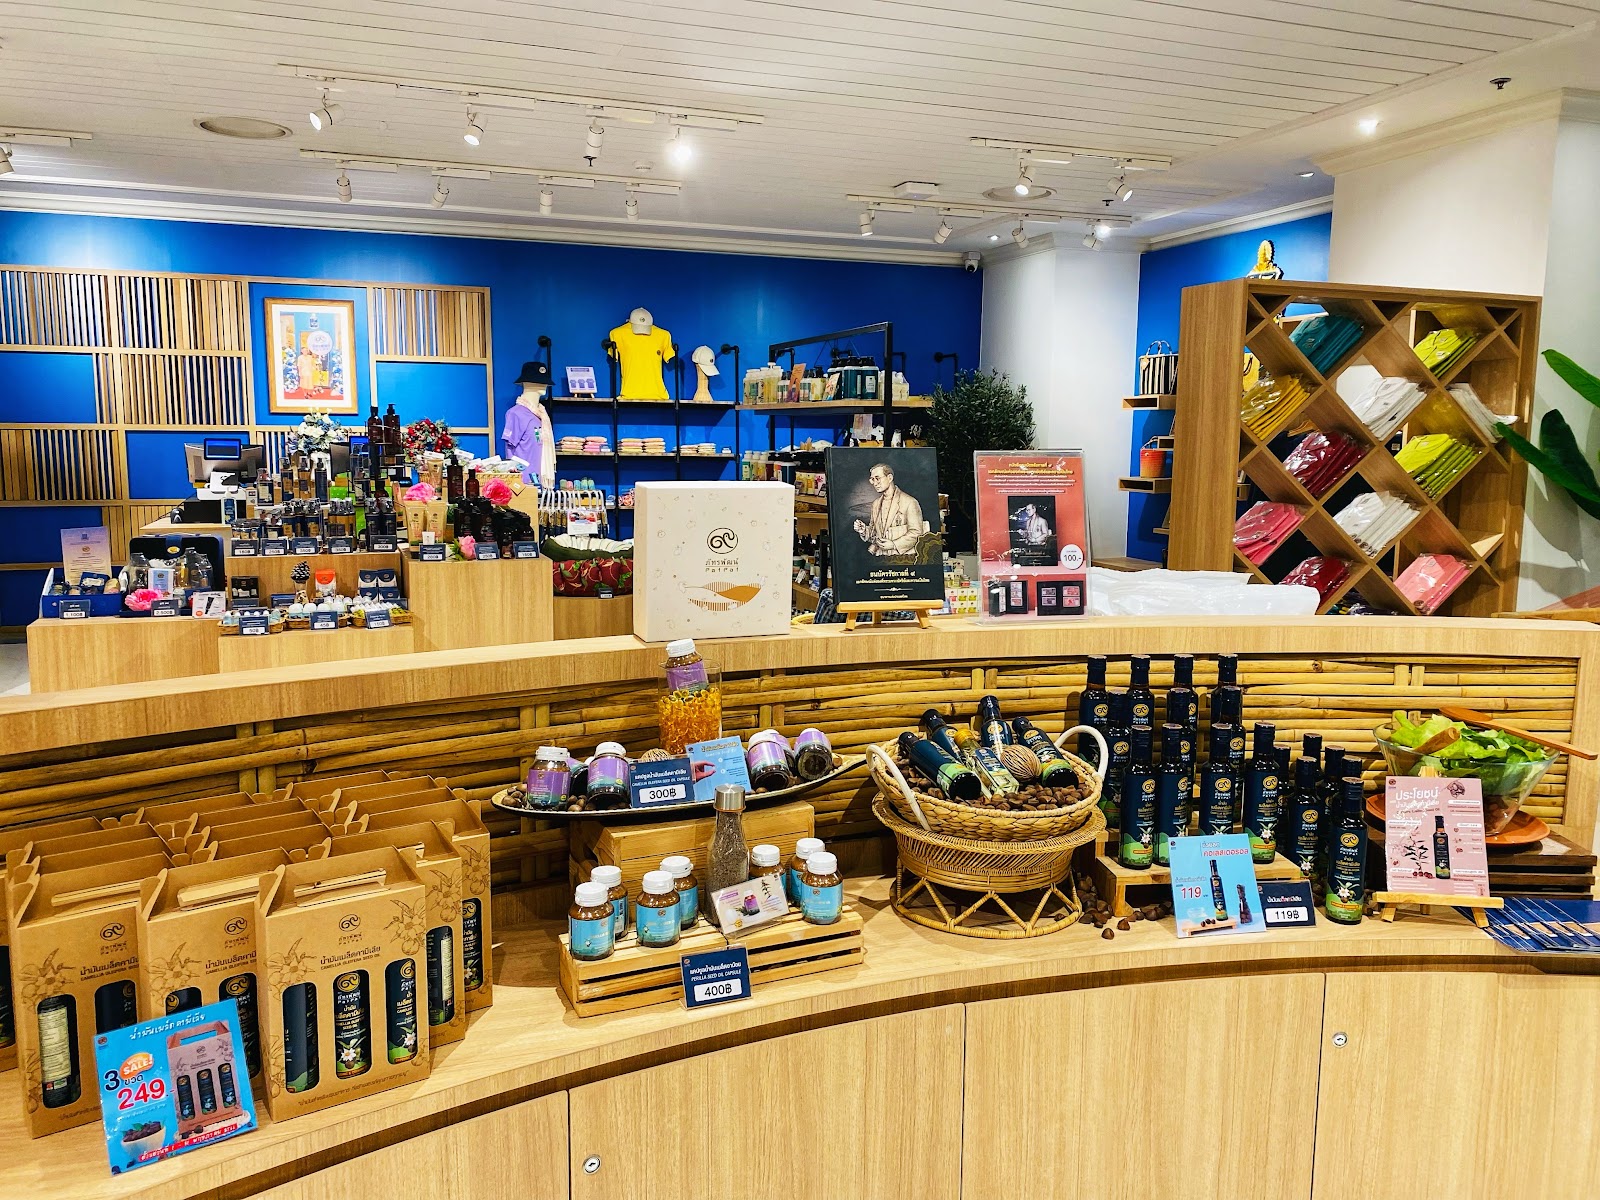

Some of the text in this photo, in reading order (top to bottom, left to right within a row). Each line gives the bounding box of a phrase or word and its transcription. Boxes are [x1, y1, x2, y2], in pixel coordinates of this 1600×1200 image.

[705, 557, 739, 567] ภัทรพัฒน์
[649, 787, 677, 800] 300฿
[1396, 786, 1439, 801] ประโยชน์
[1181, 886, 1202, 899] 119
[1275, 909, 1300, 920] 119฿
[704, 983, 732, 997] 400฿
[123, 1054, 154, 1075] SALE!
[104, 1070, 144, 1091] 3 ขวด
